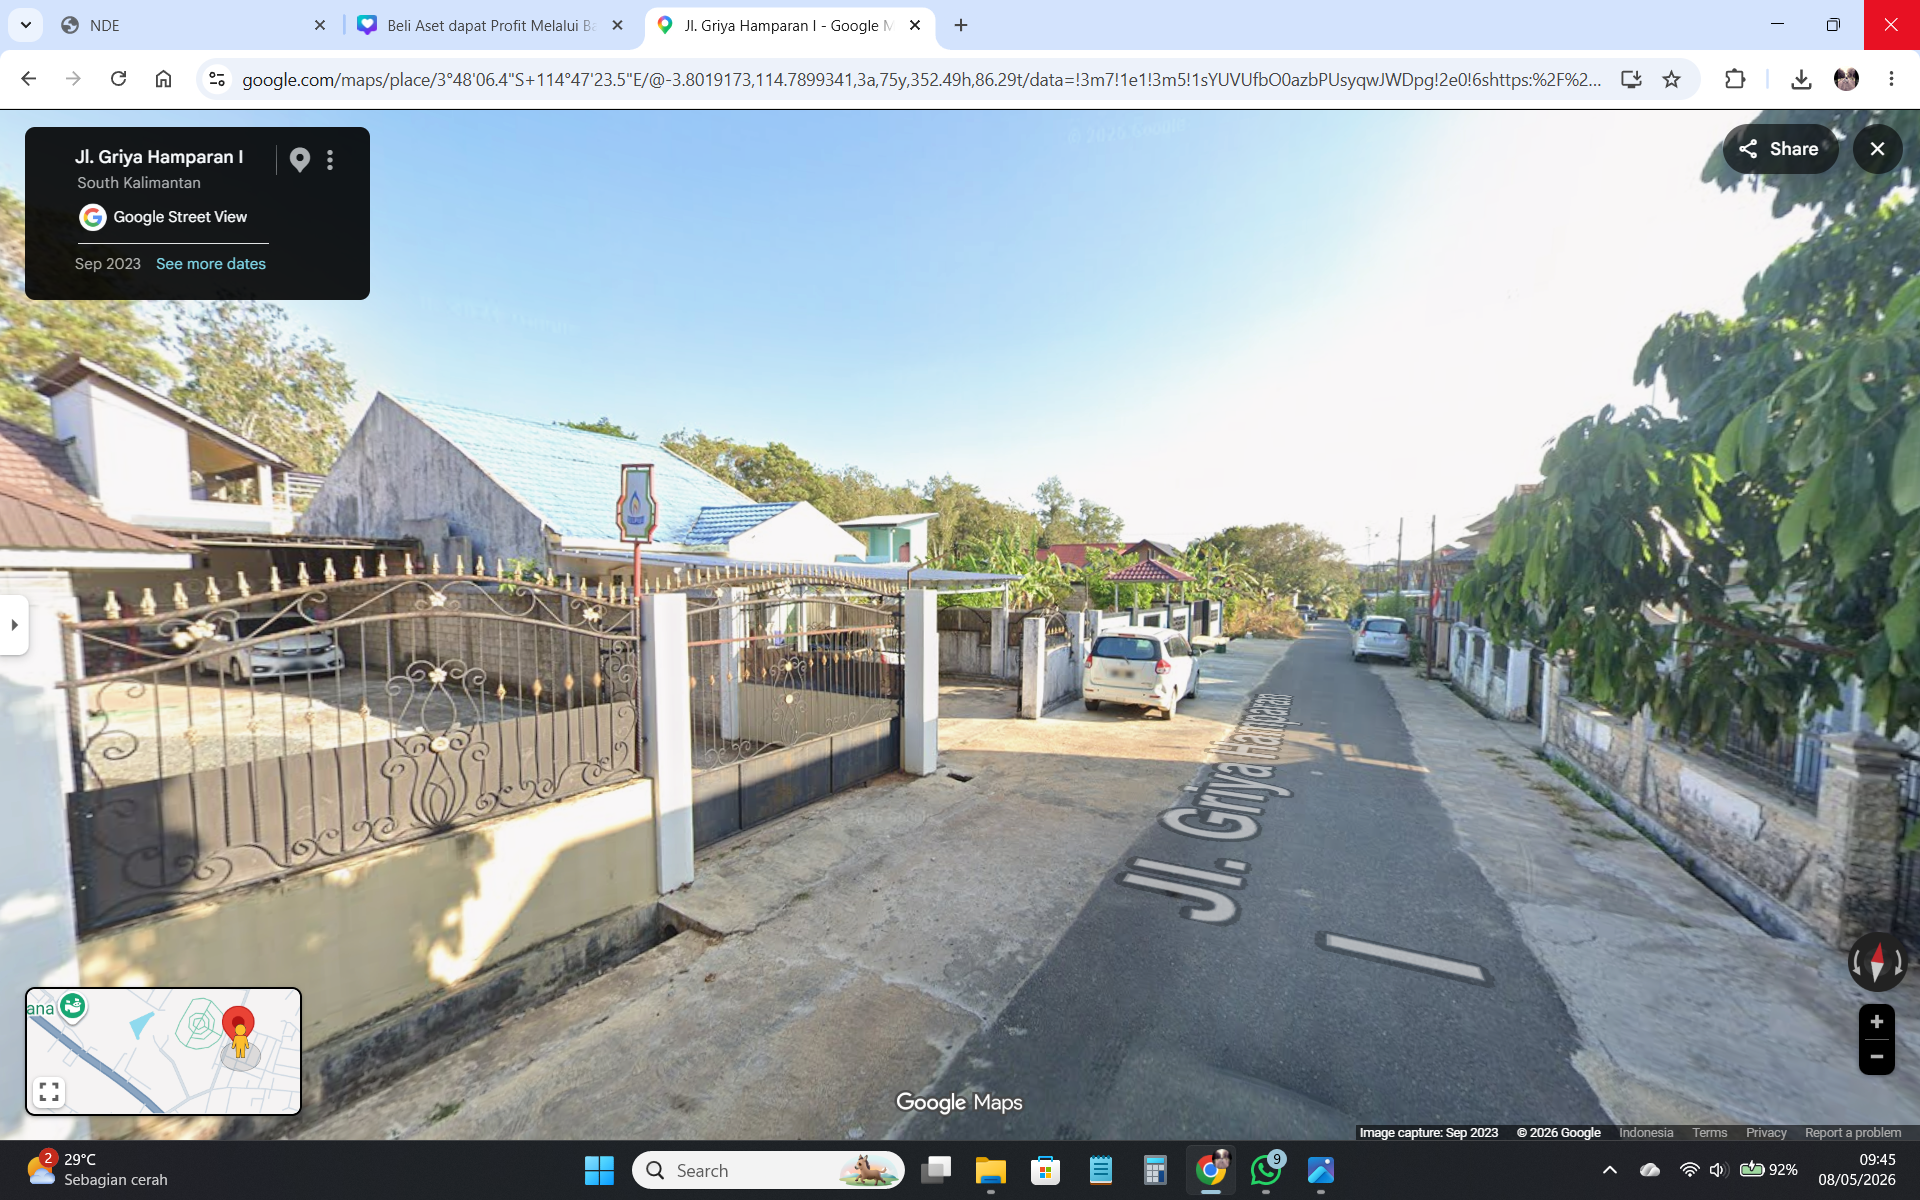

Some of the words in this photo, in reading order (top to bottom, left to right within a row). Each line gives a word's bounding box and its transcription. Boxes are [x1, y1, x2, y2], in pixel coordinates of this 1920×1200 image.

[91, 19, 120, 32] NDE
[387, 19, 412, 32] Beli
[414, 19, 445, 32] Aset
[448, 19, 487, 35] dapat
[490, 19, 527, 32] Profit
[530, 19, 579, 32] Melalui
[685, 19, 698, 34] Jl.
[701, 19, 736, 35] Griya
[740, 19, 809, 35] Hamparan
[830, 19, 880, 35] Google
[1770, 140, 1819, 157] Share
[75, 148, 95, 165] Jl.
[98, 148, 143, 168] Griya
[147, 148, 234, 168] Hamparan
[77, 175, 119, 189] South
[123, 175, 201, 189] Kalimantan
[114, 209, 165, 227] Google
[168, 209, 211, 224] Street
[214, 209, 248, 224] View
[75, 256, 103, 273] Sep
[106, 256, 141, 271] 2023
[156, 256, 184, 271] See
[187, 259, 223, 271] more
[227, 256, 267, 271] dates
[44, 1152, 53, 1164] 2
[64, 1153, 96, 1166] 29°C
[1273, 1153, 1281, 1165] 9
[1859, 1153, 1897, 1166] 09:45
[677, 1162, 729, 1179] Search
[1768, 1163, 1799, 1176] 92%
[64, 1172, 127, 1189] Sebagian
[130, 1173, 168, 1186] cerah
[1818, 1173, 1897, 1187] 08/05/2026
